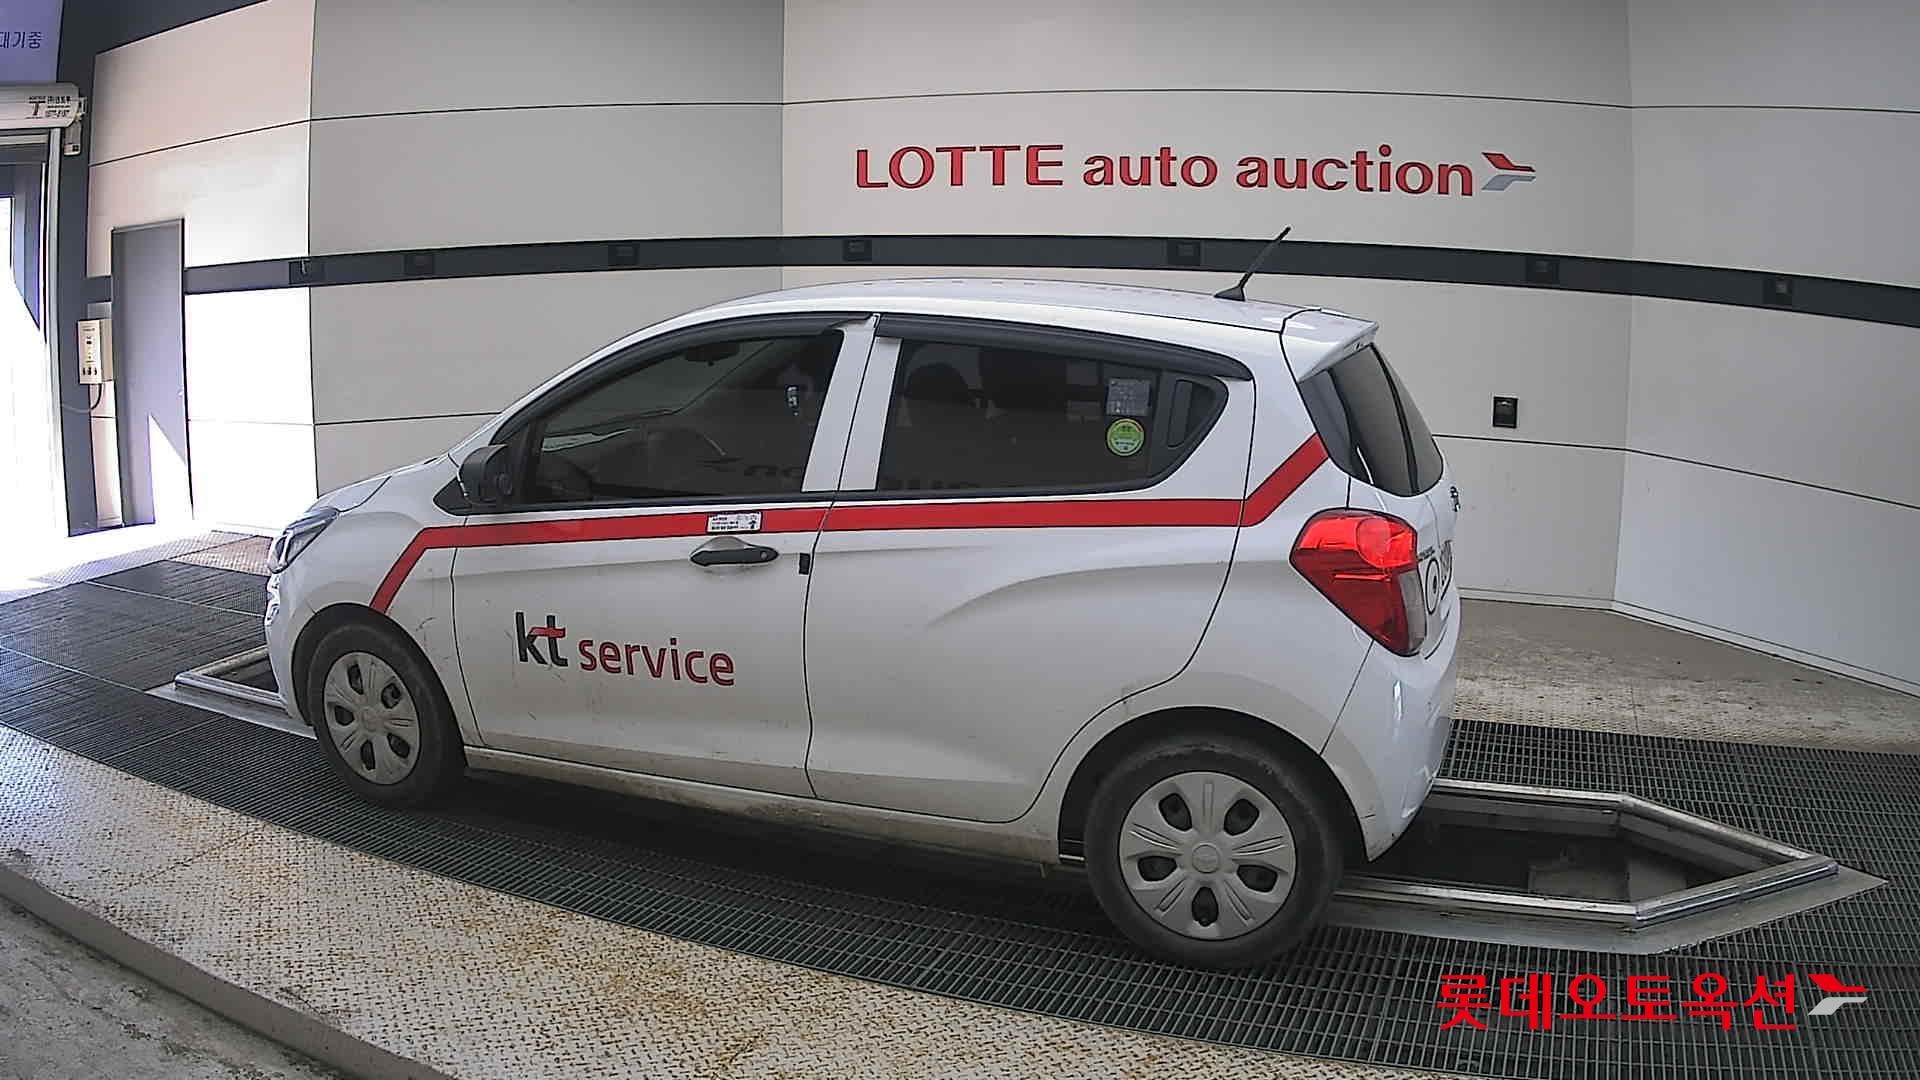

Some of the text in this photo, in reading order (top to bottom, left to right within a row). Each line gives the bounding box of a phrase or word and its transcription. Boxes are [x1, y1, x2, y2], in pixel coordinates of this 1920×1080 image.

[856, 144, 1474, 197] LOTTE auto auction
[515, 611, 735, 686] kt service
